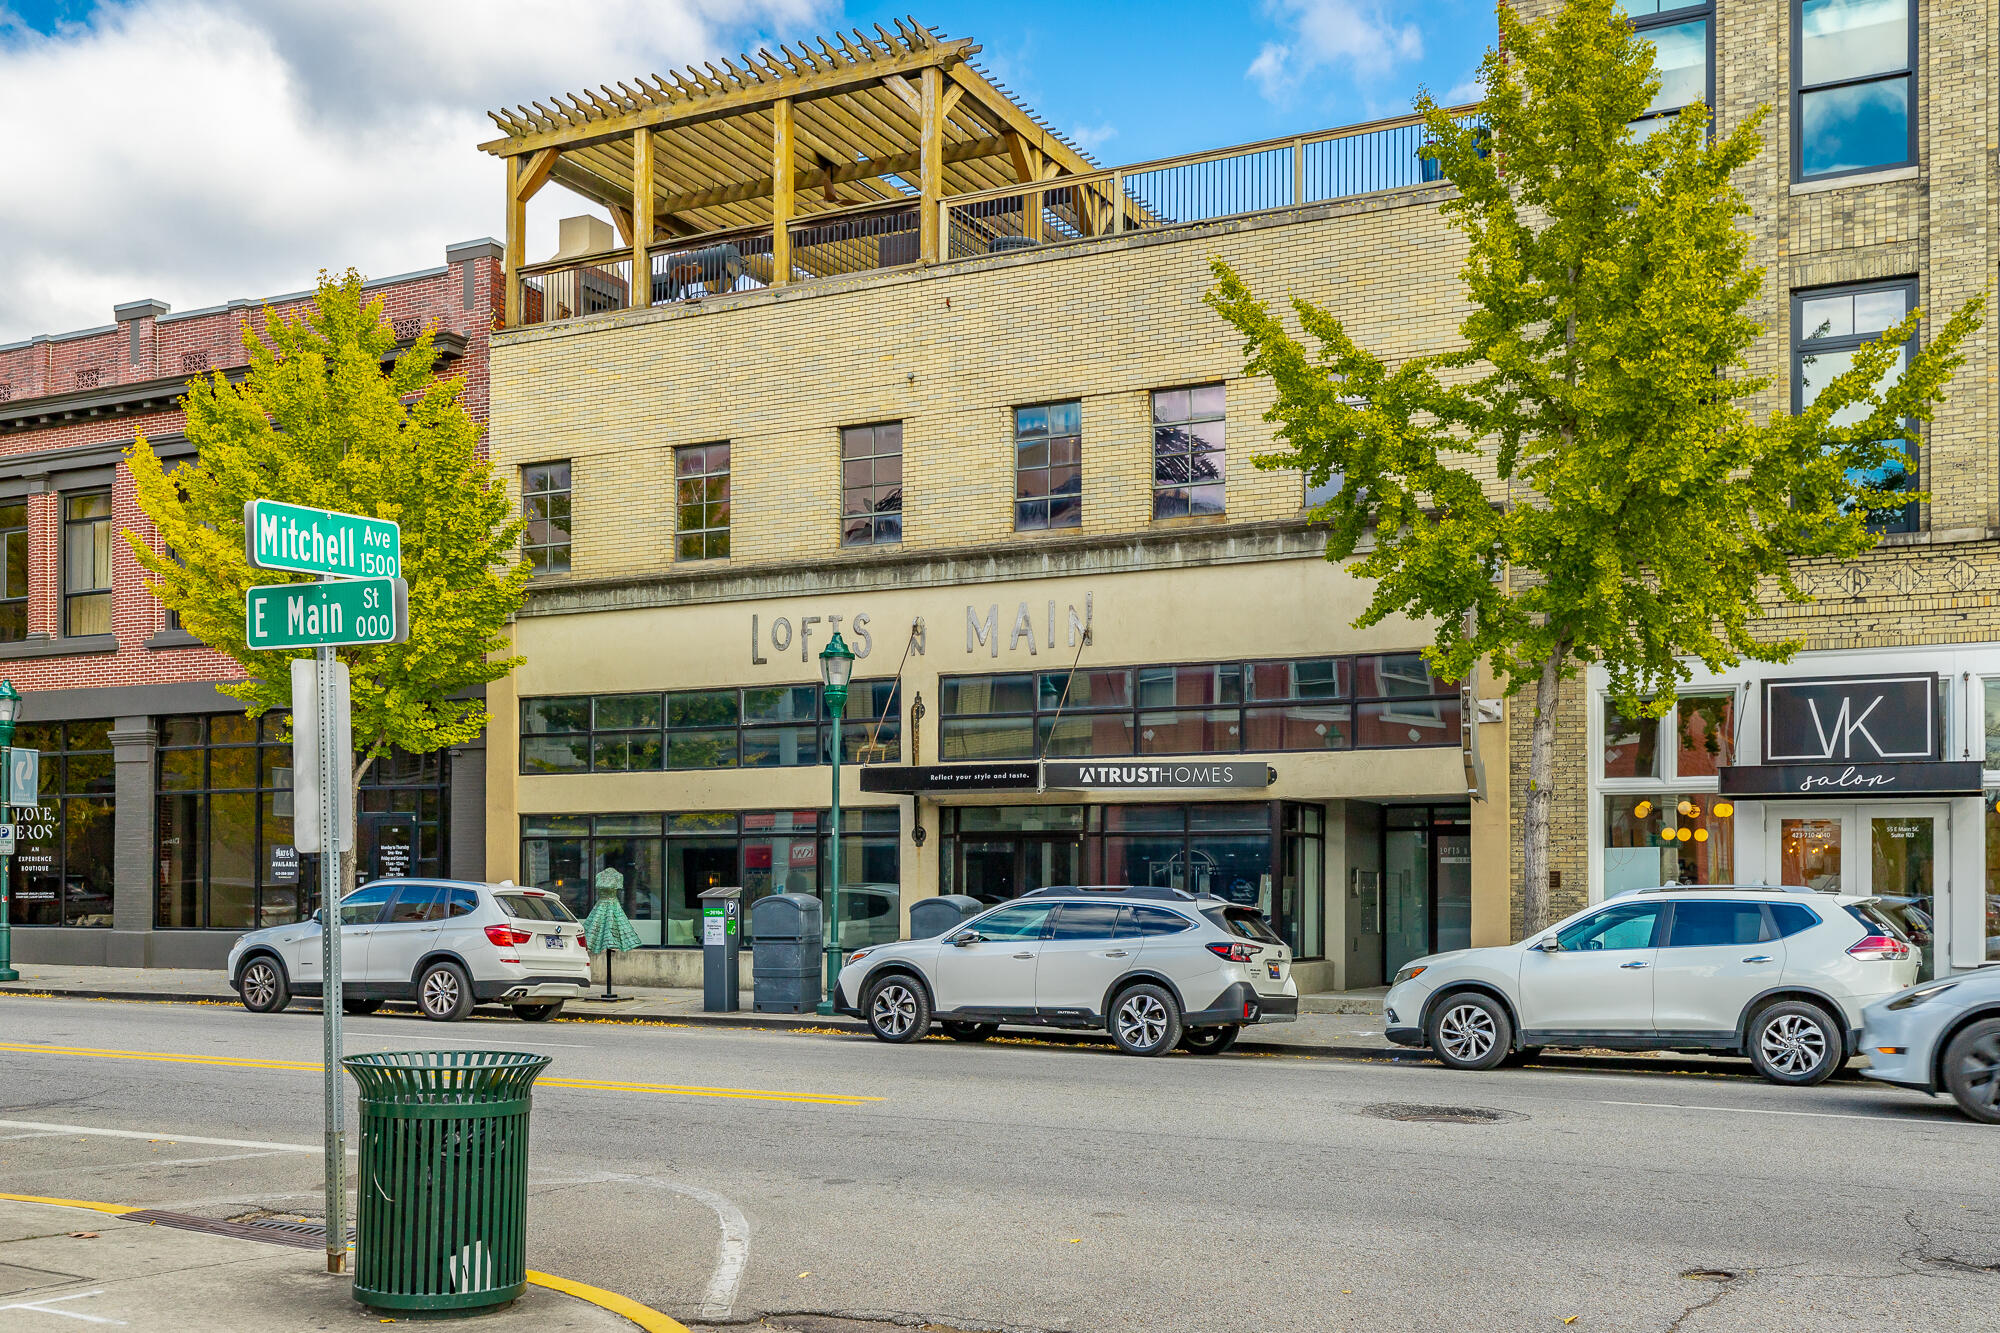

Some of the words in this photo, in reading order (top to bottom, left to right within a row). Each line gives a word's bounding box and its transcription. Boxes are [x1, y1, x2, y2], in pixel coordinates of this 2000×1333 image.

[260, 513, 355, 567] Mitchell
[363, 525, 391, 548] Ave
[360, 552, 396, 577] 1500
[255, 598, 268, 637] E
[287, 592, 343, 636] Main
[363, 587, 380, 609] St
[356, 614, 390, 637] 000
[752, 612, 873, 665] LOFTS
[966, 591, 1093, 658] MAIN
[1808, 695, 1884, 759] VK
[956, 774, 972, 782] your
[974, 773, 991, 781] style
[1800, 766, 1896, 791] salon
[16, 807, 55, 823] LOVE,
[16, 824, 53, 840] EROS
